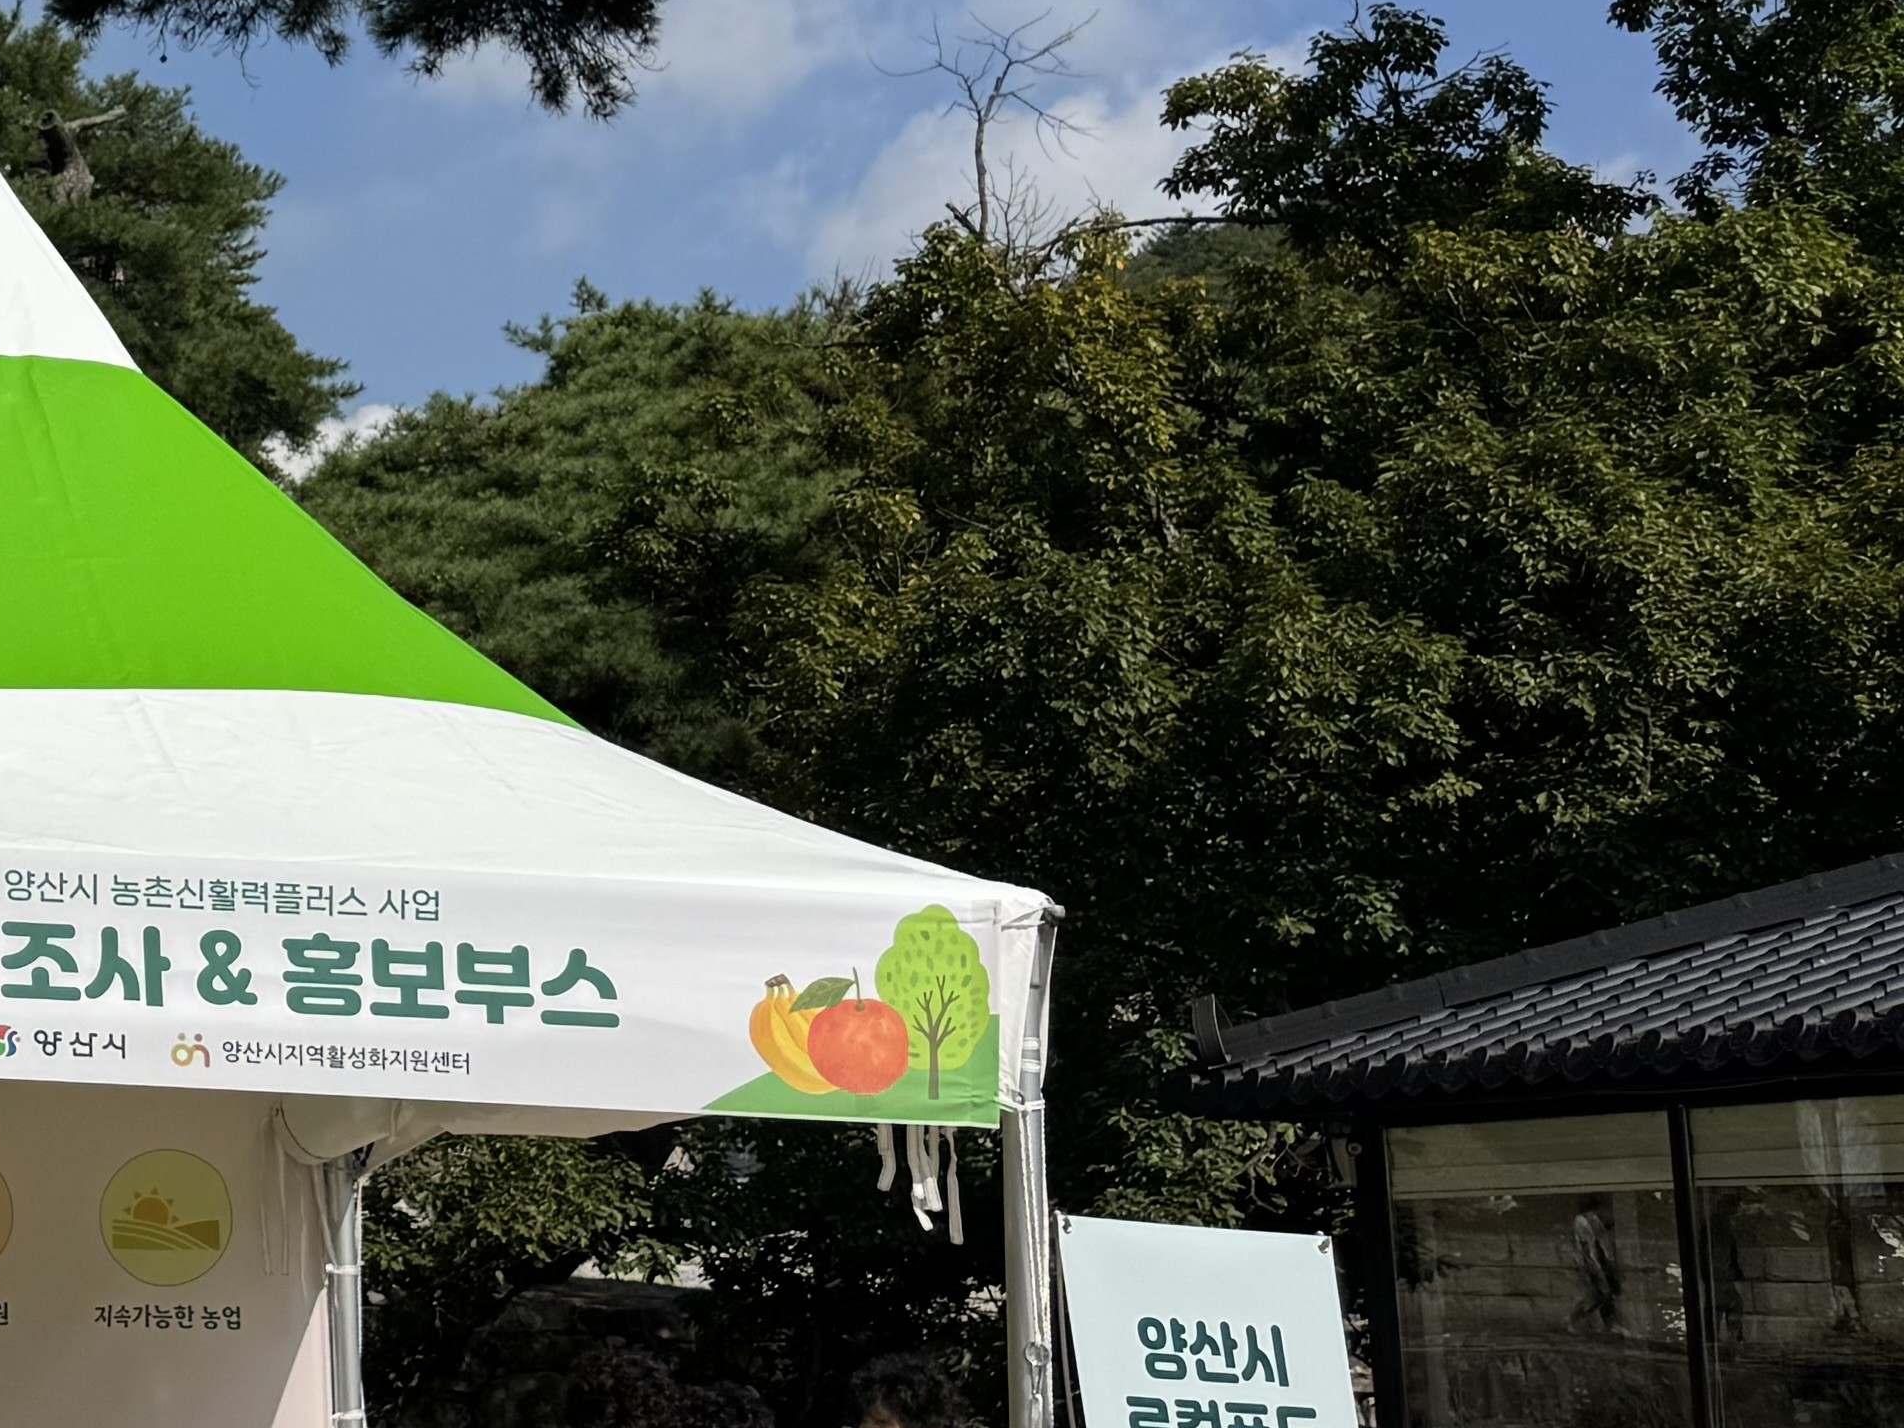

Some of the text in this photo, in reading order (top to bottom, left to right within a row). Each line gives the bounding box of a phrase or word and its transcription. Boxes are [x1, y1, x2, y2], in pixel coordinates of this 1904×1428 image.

[2, 867, 443, 924] 양산시 농촌신활력플러스 사업
[197, 927, 259, 1008] &
[281, 929, 621, 1032] 홍보부스
[31, 1026, 129, 1061] 양산시
[220, 1036, 473, 1077] 양산시지역활성화지원센터
[94, 1302, 242, 1332] 지속가능한 농업
[1137, 1316, 1290, 1387] 양산시
